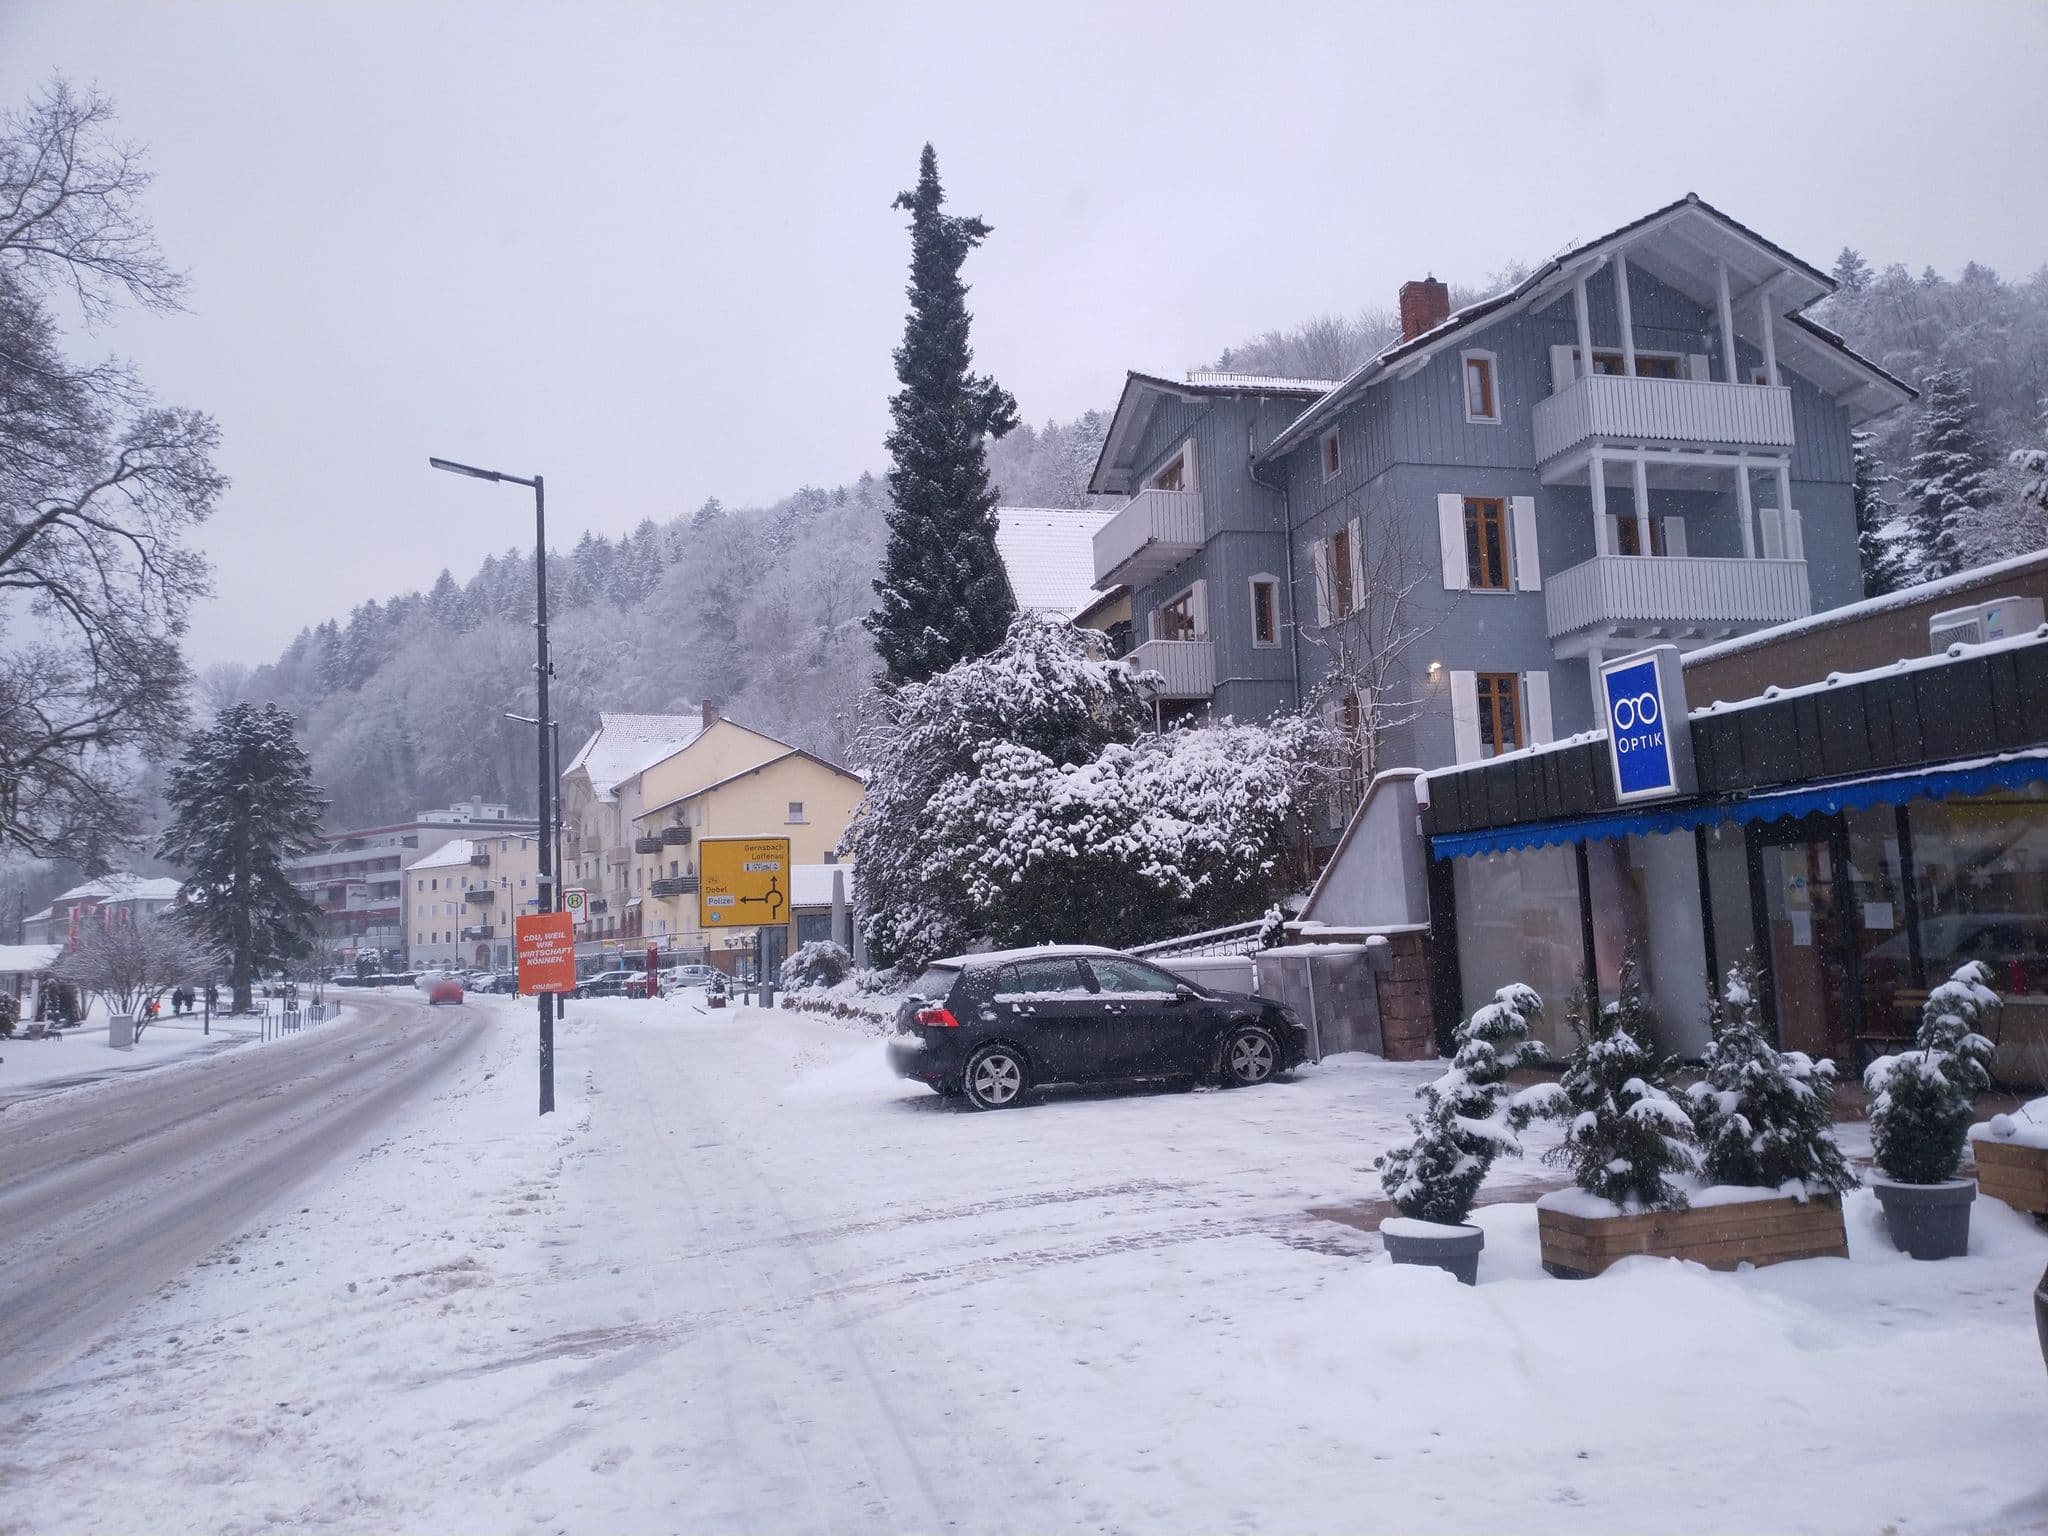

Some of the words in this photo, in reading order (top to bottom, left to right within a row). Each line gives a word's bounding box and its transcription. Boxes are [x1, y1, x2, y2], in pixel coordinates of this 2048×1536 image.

[1618, 732, 1663, 753] OPTIK
[744, 844, 784, 852] Gernsbach
[751, 853, 784, 861] Loffenau
[705, 886, 728, 894] Dobel
[708, 897, 734, 905] Polizei
[523, 934, 543, 942] CDU,
[544, 931, 567, 940] WEIL
[536, 941, 554, 949] WIR
[519, 946, 573, 958] WIRTSCHAFT
[527, 956, 565, 966] KÖNNEN.
